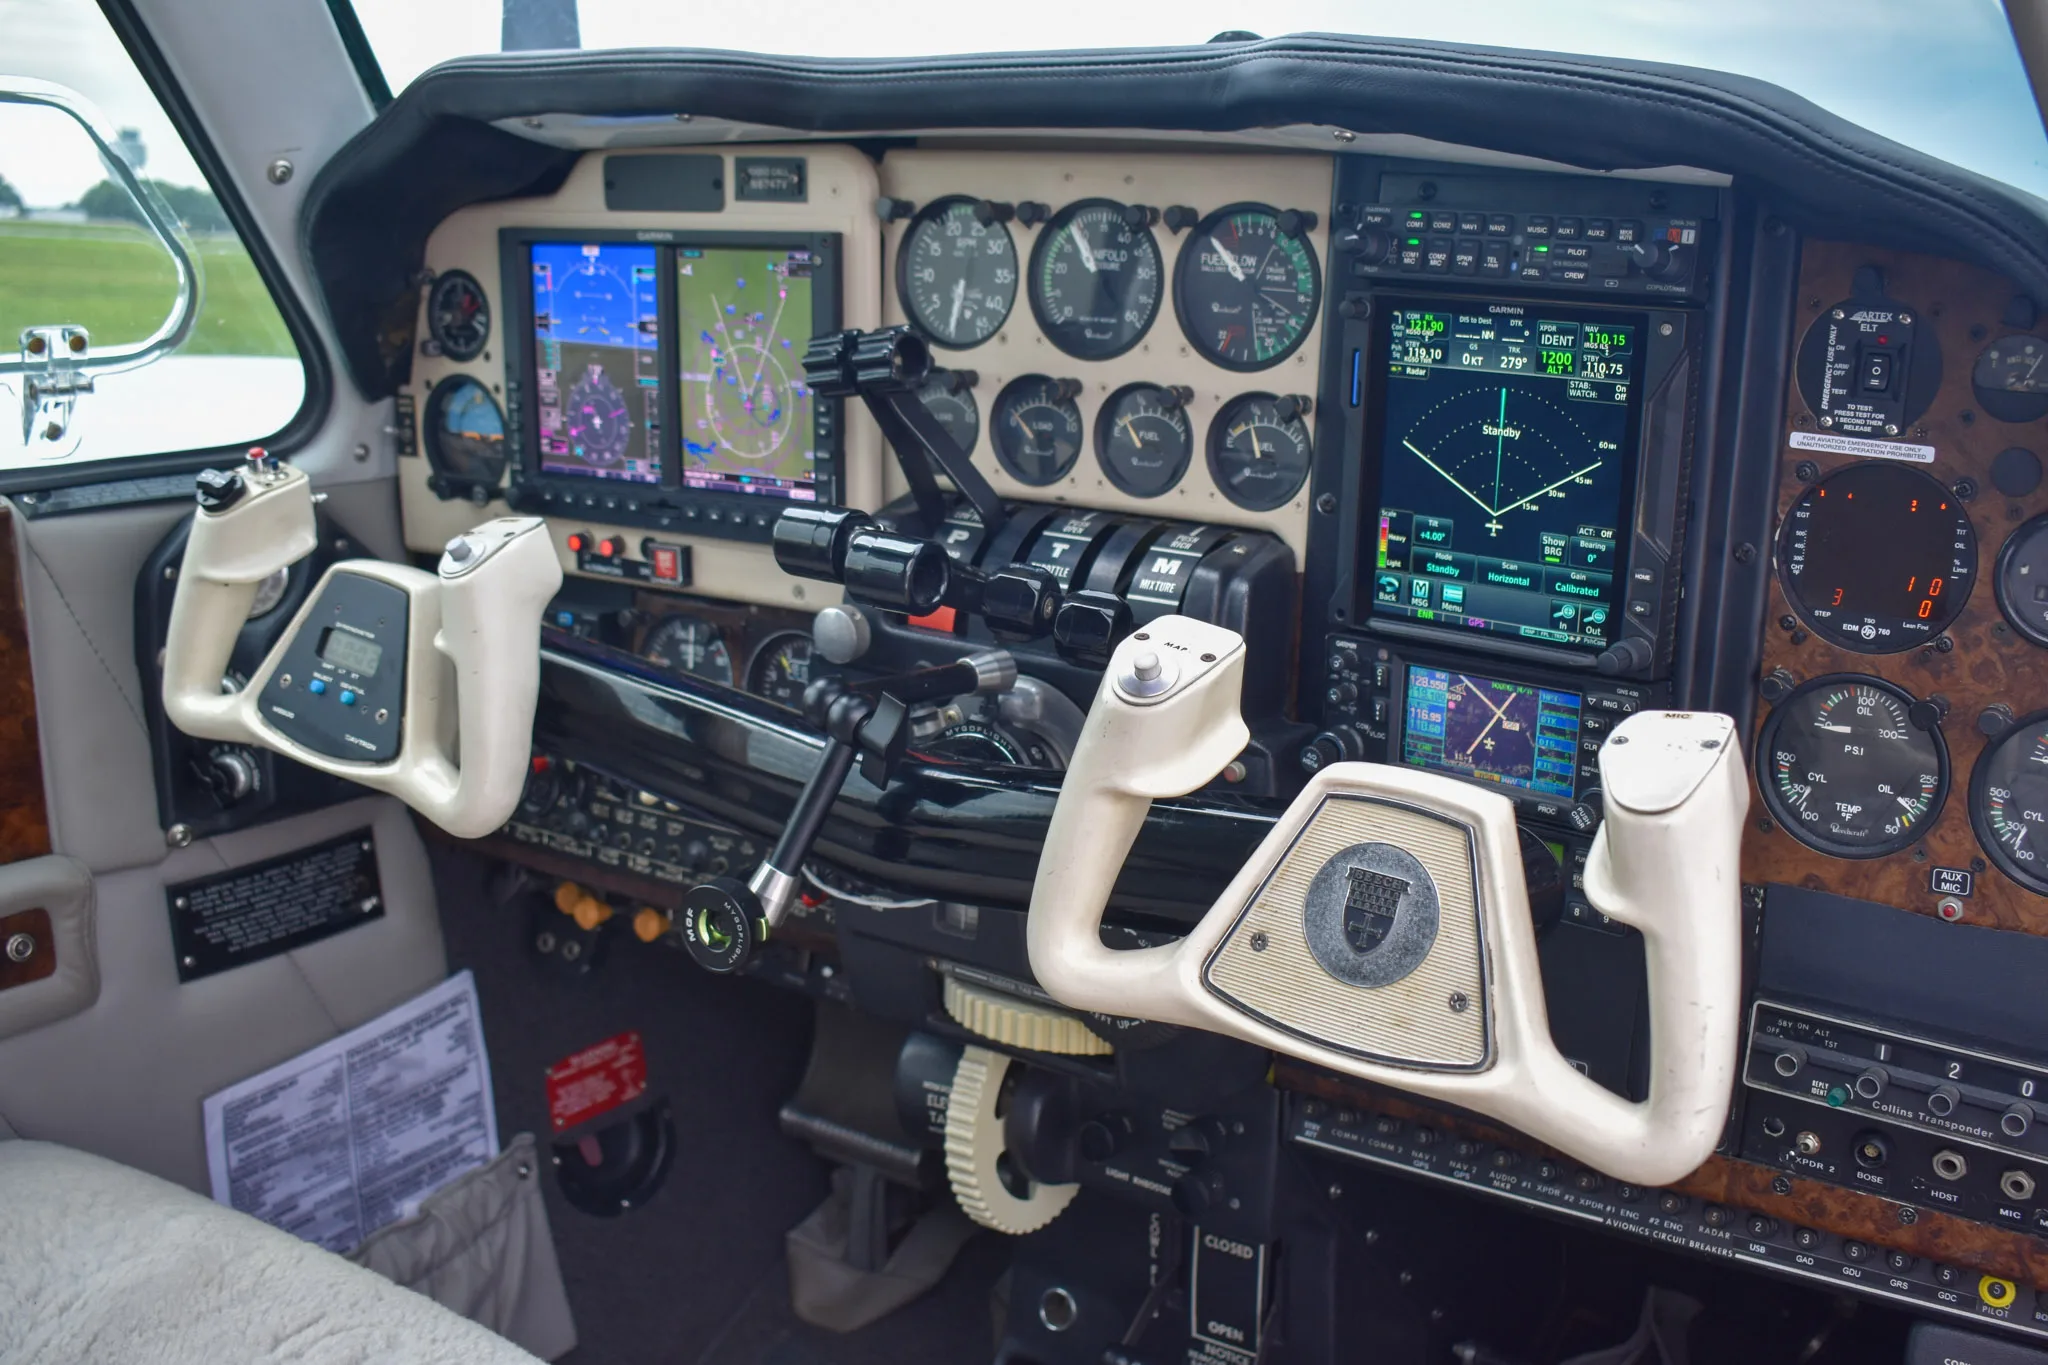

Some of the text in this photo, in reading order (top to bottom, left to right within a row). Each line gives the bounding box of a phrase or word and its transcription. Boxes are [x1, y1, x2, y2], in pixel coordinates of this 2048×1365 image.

[947, 222, 962, 236] 20
[1527, 226, 1547, 234] MUSIC
[1587, 229, 1605, 237] AUX2
[1118, 233, 1131, 243] 40
[987, 240, 1003, 254] 30
[1055, 264, 1067, 274] 20
[1137, 268, 1150, 279] 50
[995, 269, 1011, 283] 35
[1125, 310, 1138, 322] 60
[1489, 306, 1523, 315] GARMIN
[1861, 311, 1893, 321] ARTEX
[1410, 320, 1444, 332] 121.90
[1860, 324, 1878, 332] ELT
[1542, 334, 1574, 346] IDENT
[1589, 333, 1625, 345] 110.15
[1408, 348, 1442, 359] 119.10
[1542, 352, 1572, 364] 1200
[1406, 368, 1426, 376] Radar
[1587, 362, 1622, 374] 110.75
[1821, 324, 1838, 409] EMERGENCY USE ONLY
[1570, 381, 1591, 389] STAB:
[1570, 390, 1598, 398] WATCH:
[1139, 431, 1159, 441] FUEL
[1483, 425, 1521, 440] Standby
[1817, 437, 1846, 445] AVIATION
[1848, 440, 1888, 449] EMERGENCY
[1796, 441, 1926, 460] UNAUTHORIZED OPERATION PROHIBITED
[1063, 526, 1085, 534] OPEN
[1579, 528, 1612, 538] ACT: Off
[947, 530, 969, 544] P
[1176, 535, 1200, 543] PUSH
[1542, 536, 1565, 547] Show
[1052, 543, 1070, 558] T
[1170, 541, 1192, 550] RICH
[1580, 540, 1606, 551] Bearing
[1435, 552, 1452, 561] Mode
[1544, 547, 1562, 556] BRG
[1151, 558, 1182, 575] M
[1427, 563, 1459, 577] Standby
[1502, 562, 1518, 570] Scan
[1488, 572, 1530, 586] Horizontal
[1571, 572, 1586, 581] Gain
[1635, 573, 1650, 581] HOME
[1139, 579, 1176, 593] MIXTURE
[1555, 583, 1599, 597] Calibrated
[1379, 592, 1396, 601] Back
[1412, 598, 1428, 607] MSG
[1442, 603, 1462, 612] Menu
[1417, 609, 1434, 620] ENR
[1468, 618, 1484, 627] GPS
[1560, 622, 1567, 630] In
[1586, 626, 1601, 635] Out
[1164, 642, 1188, 651] MAP
[1603, 701, 1617, 709] RNG
[1858, 697, 1875, 706] 100
[1857, 707, 1872, 716] OIL
[946, 724, 1013, 751] MYGOFLIGHT
[1879, 729, 1897, 739] 200
[1777, 751, 1795, 762] 500
[1808, 773, 1827, 783] CYL
[1920, 774, 1938, 784] 250
[1878, 784, 1893, 794] OIL
[1990, 788, 2010, 799] 500
[1538, 806, 1556, 815] PROC
[1836, 803, 1861, 813] TEMP
[1802, 811, 1818, 821] 100
[2024, 811, 2044, 822] CYL
[1885, 825, 1898, 834] 50
[2016, 850, 2034, 860] 100
[1355, 870, 1400, 888] BEECH
[1941, 873, 1963, 882] AUX
[1941, 882, 1960, 893] MIC
[686, 908, 696, 941] MGF
[724, 902, 744, 963] MYGOFLIGHT
[1117, 1020, 1130, 1029] UP
[1767, 1027, 1780, 1035] OFF
[1815, 1029, 1830, 1037] ALT
[1824, 1040, 1838, 1048] TST
[1949, 1063, 1960, 1079] 2
[1812, 1080, 1829, 1088] REPLY
[2022, 1081, 2033, 1096] 0
[1811, 1088, 1827, 1097] IDENT
[1872, 1101, 1994, 1139] Collins Transponder
[1489, 1171, 1517, 1183] AUDIO
[1857, 1172, 1884, 1184] BOSE
[1931, 1190, 1958, 1202] HDST
[2000, 1208, 2021, 1219] MIC
[1606, 1218, 1733, 1257] AVIONICS CIRCUIT BREAKERS
[1699, 1225, 1730, 1240] RADAR
[1205, 1235, 1253, 1259] CLOSED
[1750, 1244, 1766, 1253] USB
[1796, 1255, 1814, 1265] GAD
[1843, 1267, 1861, 1277] GDU
[1890, 1279, 1908, 1290] GRS
[1938, 1291, 1957, 1302] GDC
[1982, 1305, 2010, 1318] PILOT
[1208, 1321, 1244, 1341] OPEN
